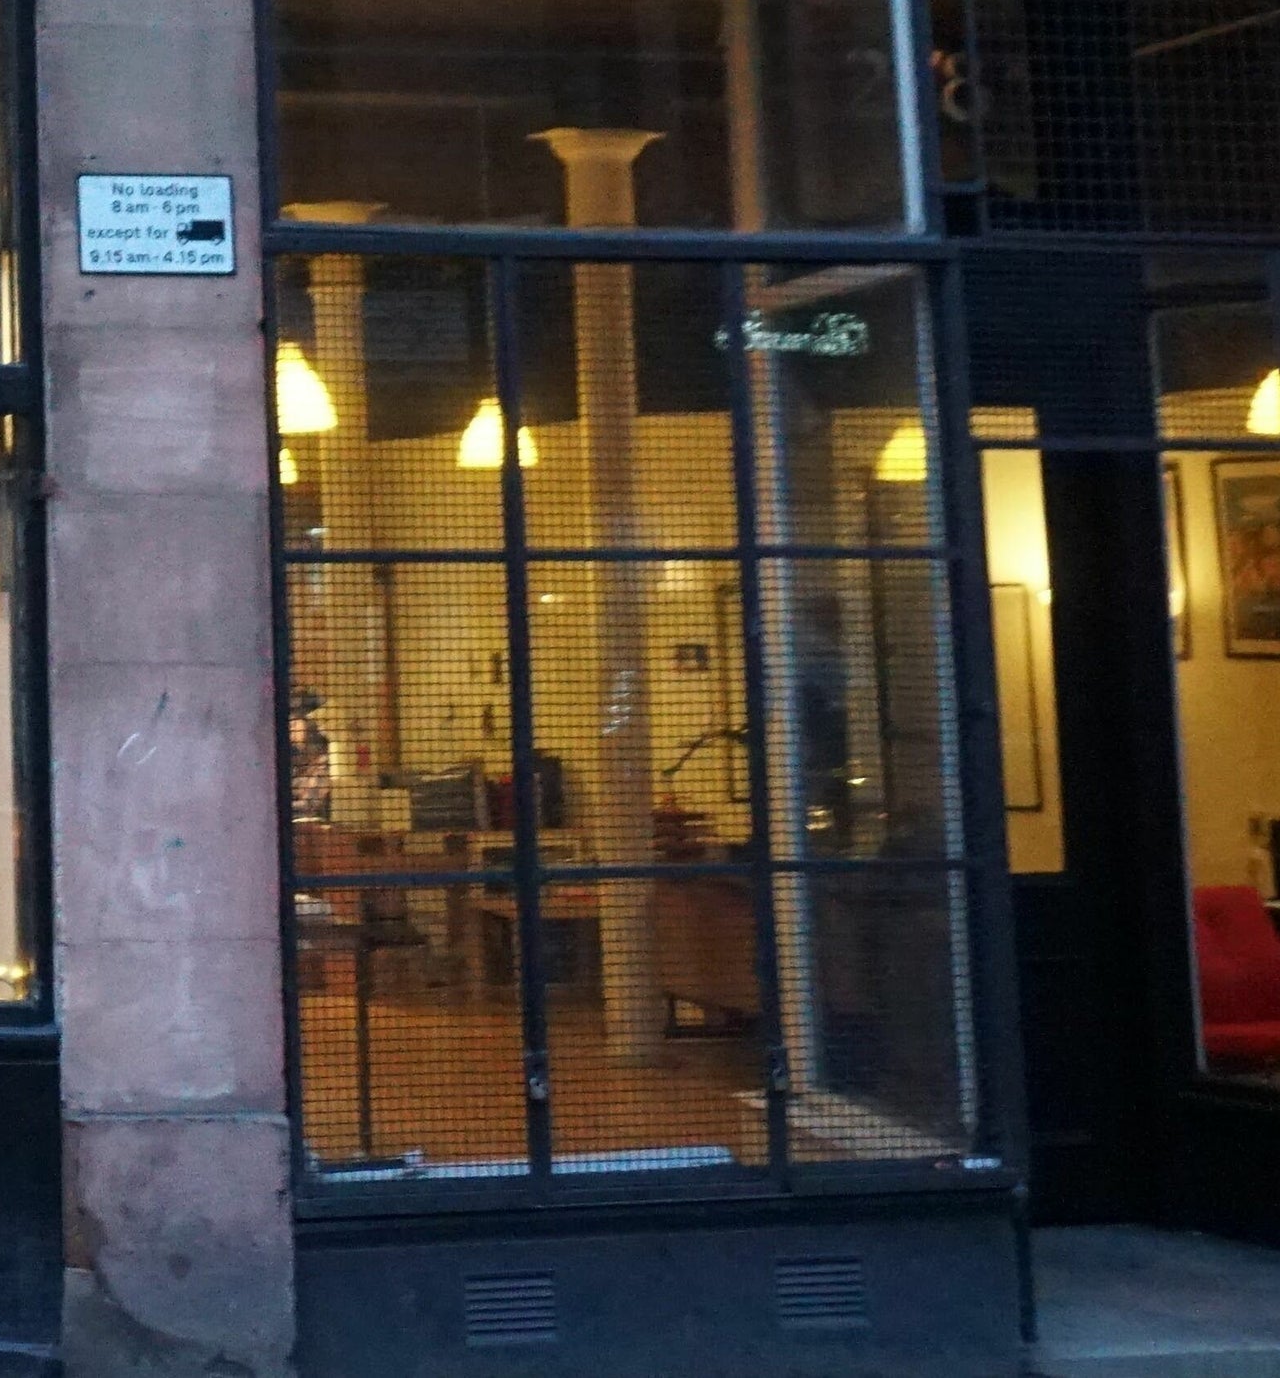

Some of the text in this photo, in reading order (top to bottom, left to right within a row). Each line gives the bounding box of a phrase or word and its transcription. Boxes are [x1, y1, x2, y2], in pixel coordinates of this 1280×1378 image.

[112, 182, 198, 199] No loading
[112, 200, 122, 213] 8
[125, 203, 149, 213] am
[162, 200, 172, 214] 6
[176, 203, 200, 216] pm
[88, 225, 169, 243] except for
[126, 252, 151, 263] am
[200, 252, 225, 265] pm
